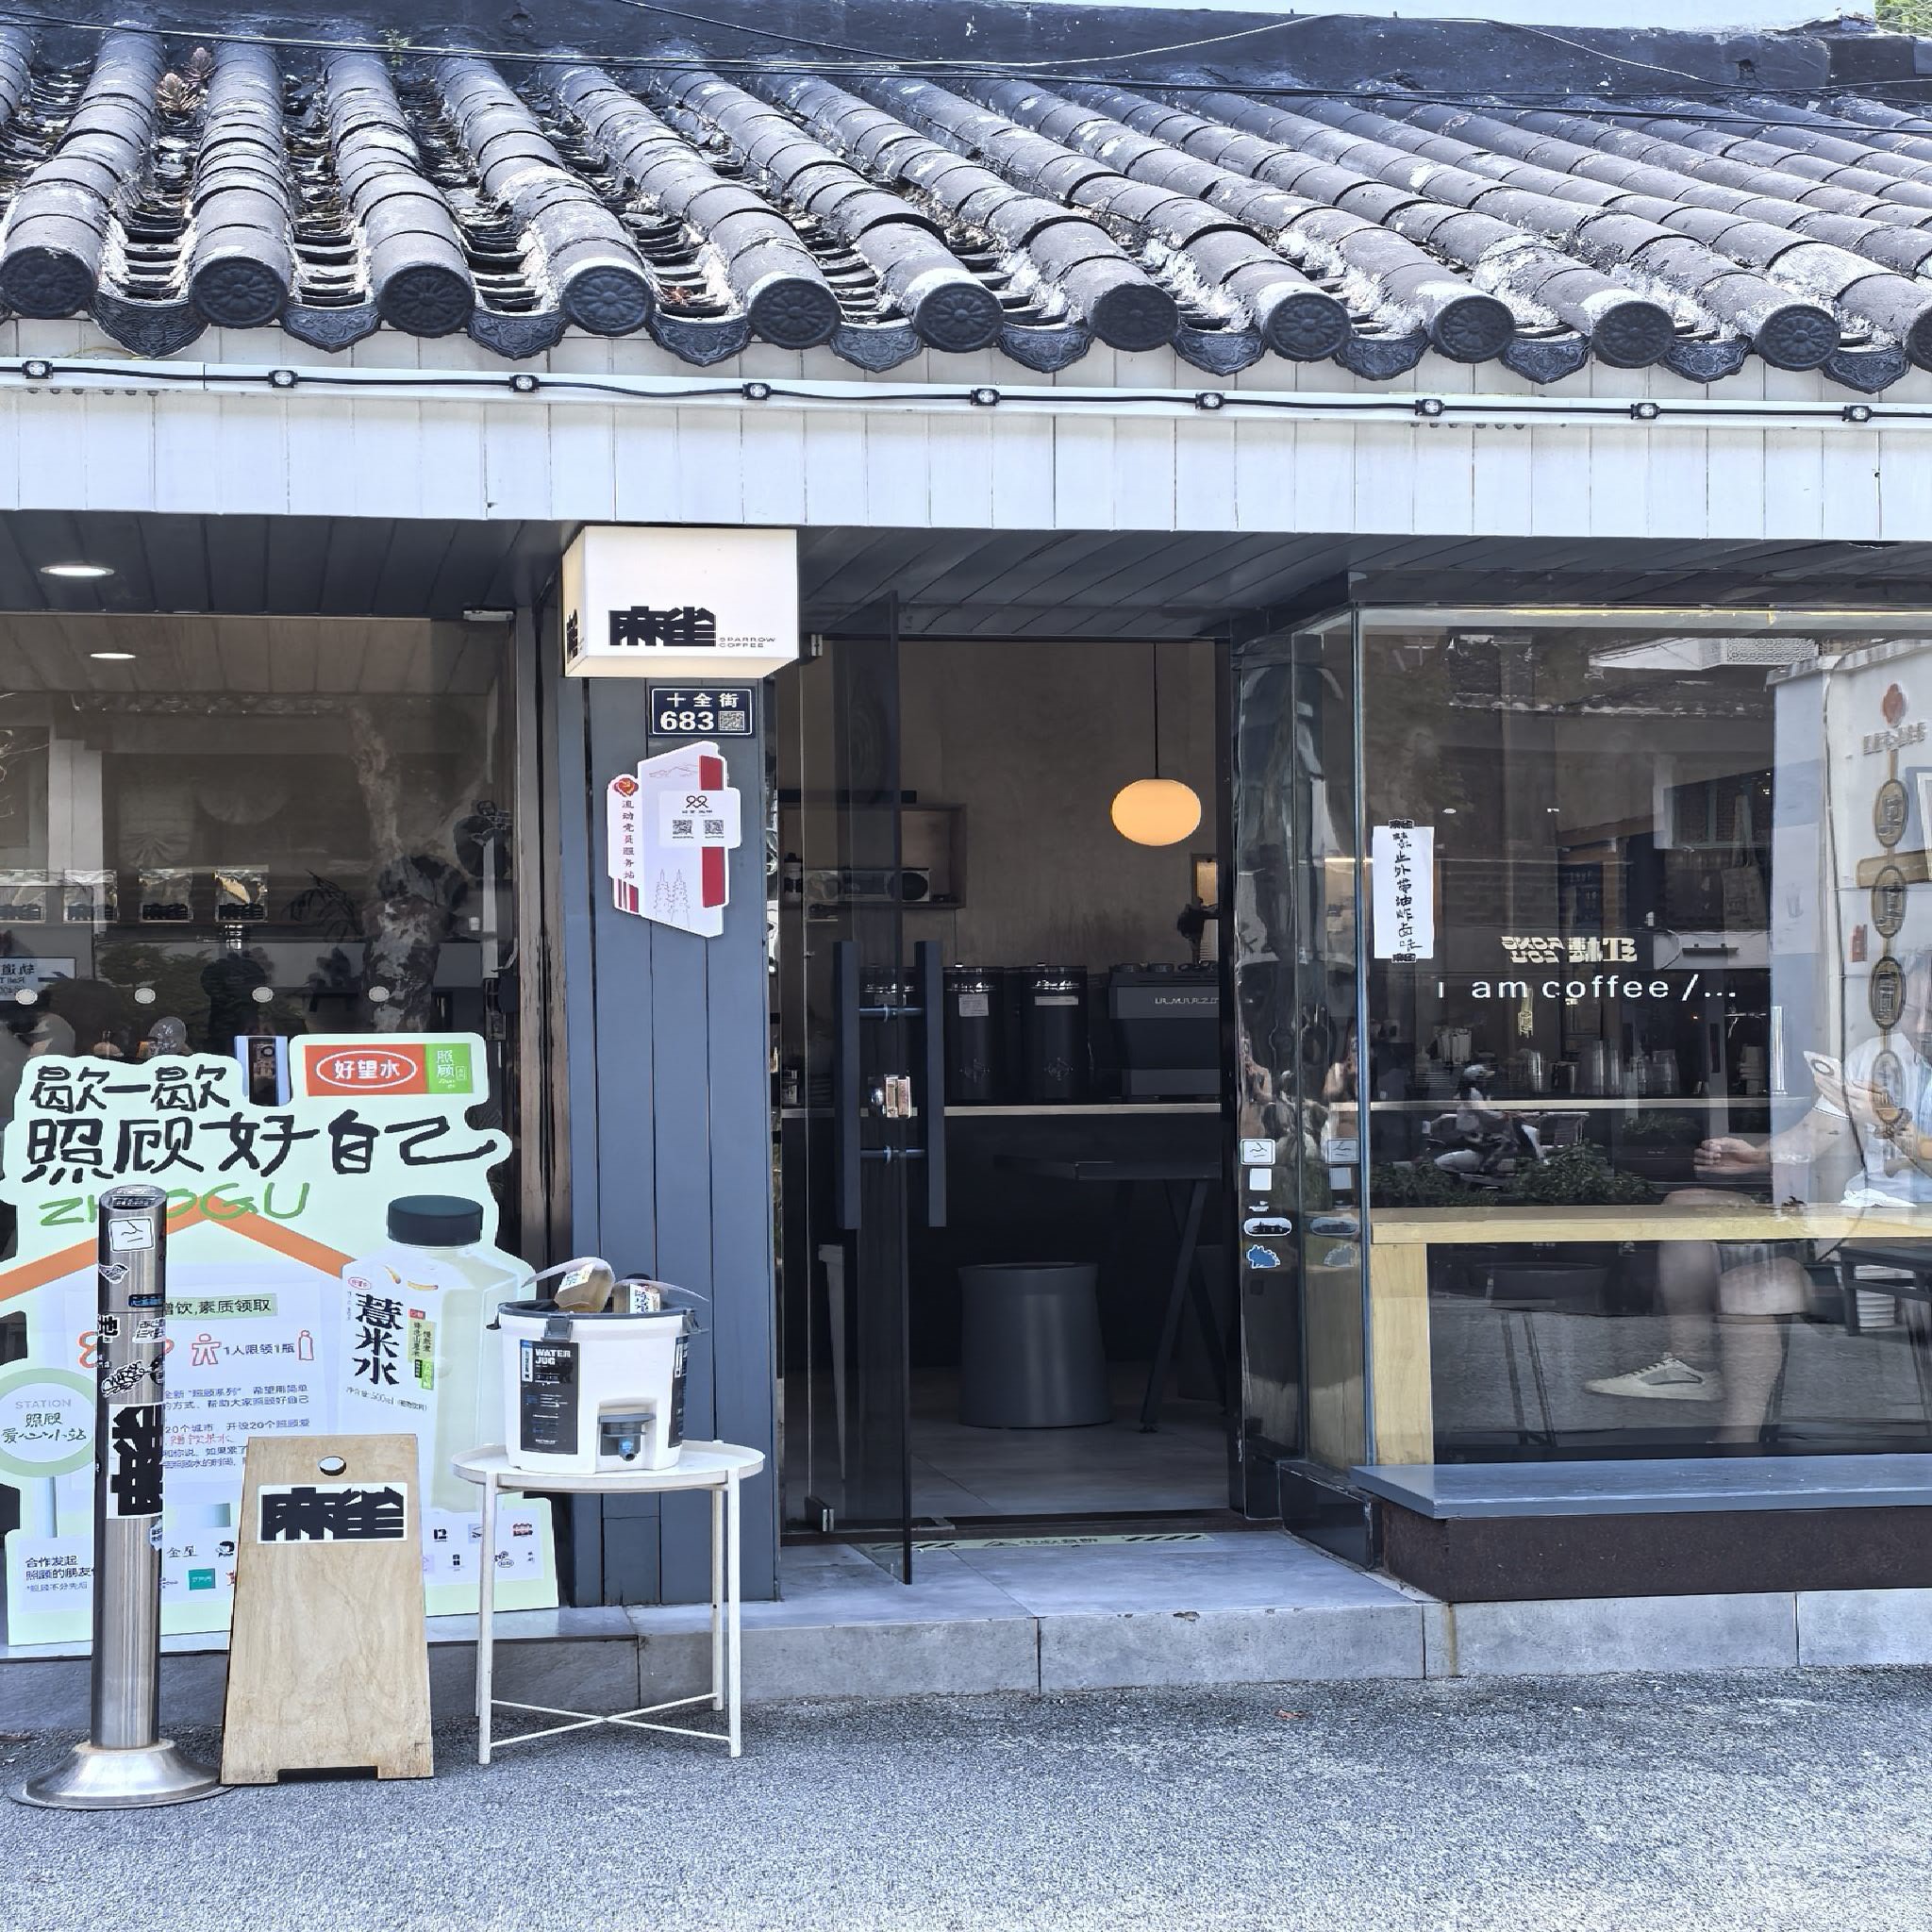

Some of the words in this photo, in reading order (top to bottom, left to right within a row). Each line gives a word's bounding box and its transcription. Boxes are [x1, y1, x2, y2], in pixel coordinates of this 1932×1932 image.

[608, 606, 716, 646] 麻雀
[666, 692, 740, 708] 十全街
[659, 711, 715, 731] 683
[1471, 980, 1528, 999] am
[1541, 974, 1670, 999] coffee
[334, 1059, 400, 1079] 好望水
[29, 1064, 232, 1113] 歇一歇
[21, 1109, 499, 1185] 照顾好自己
[39, 1182, 309, 1225] ZOGU
[352, 1292, 404, 1385] 薏米水
[224, 1343, 295, 1356] 1人限领1瓶
[535, 1348, 571, 1358] WATER
[535, 1357, 556, 1365] JUG
[15, 1399, 72, 1409] STATION
[25, 1412, 63, 1427] 照顾
[3, 1427, 87, 1443] 爱心小站
[261, 1486, 405, 1541] 麻雀
[25, 1556, 78, 1567] 合作发起
[25, 1567, 95, 1580] 照顾的朋友
